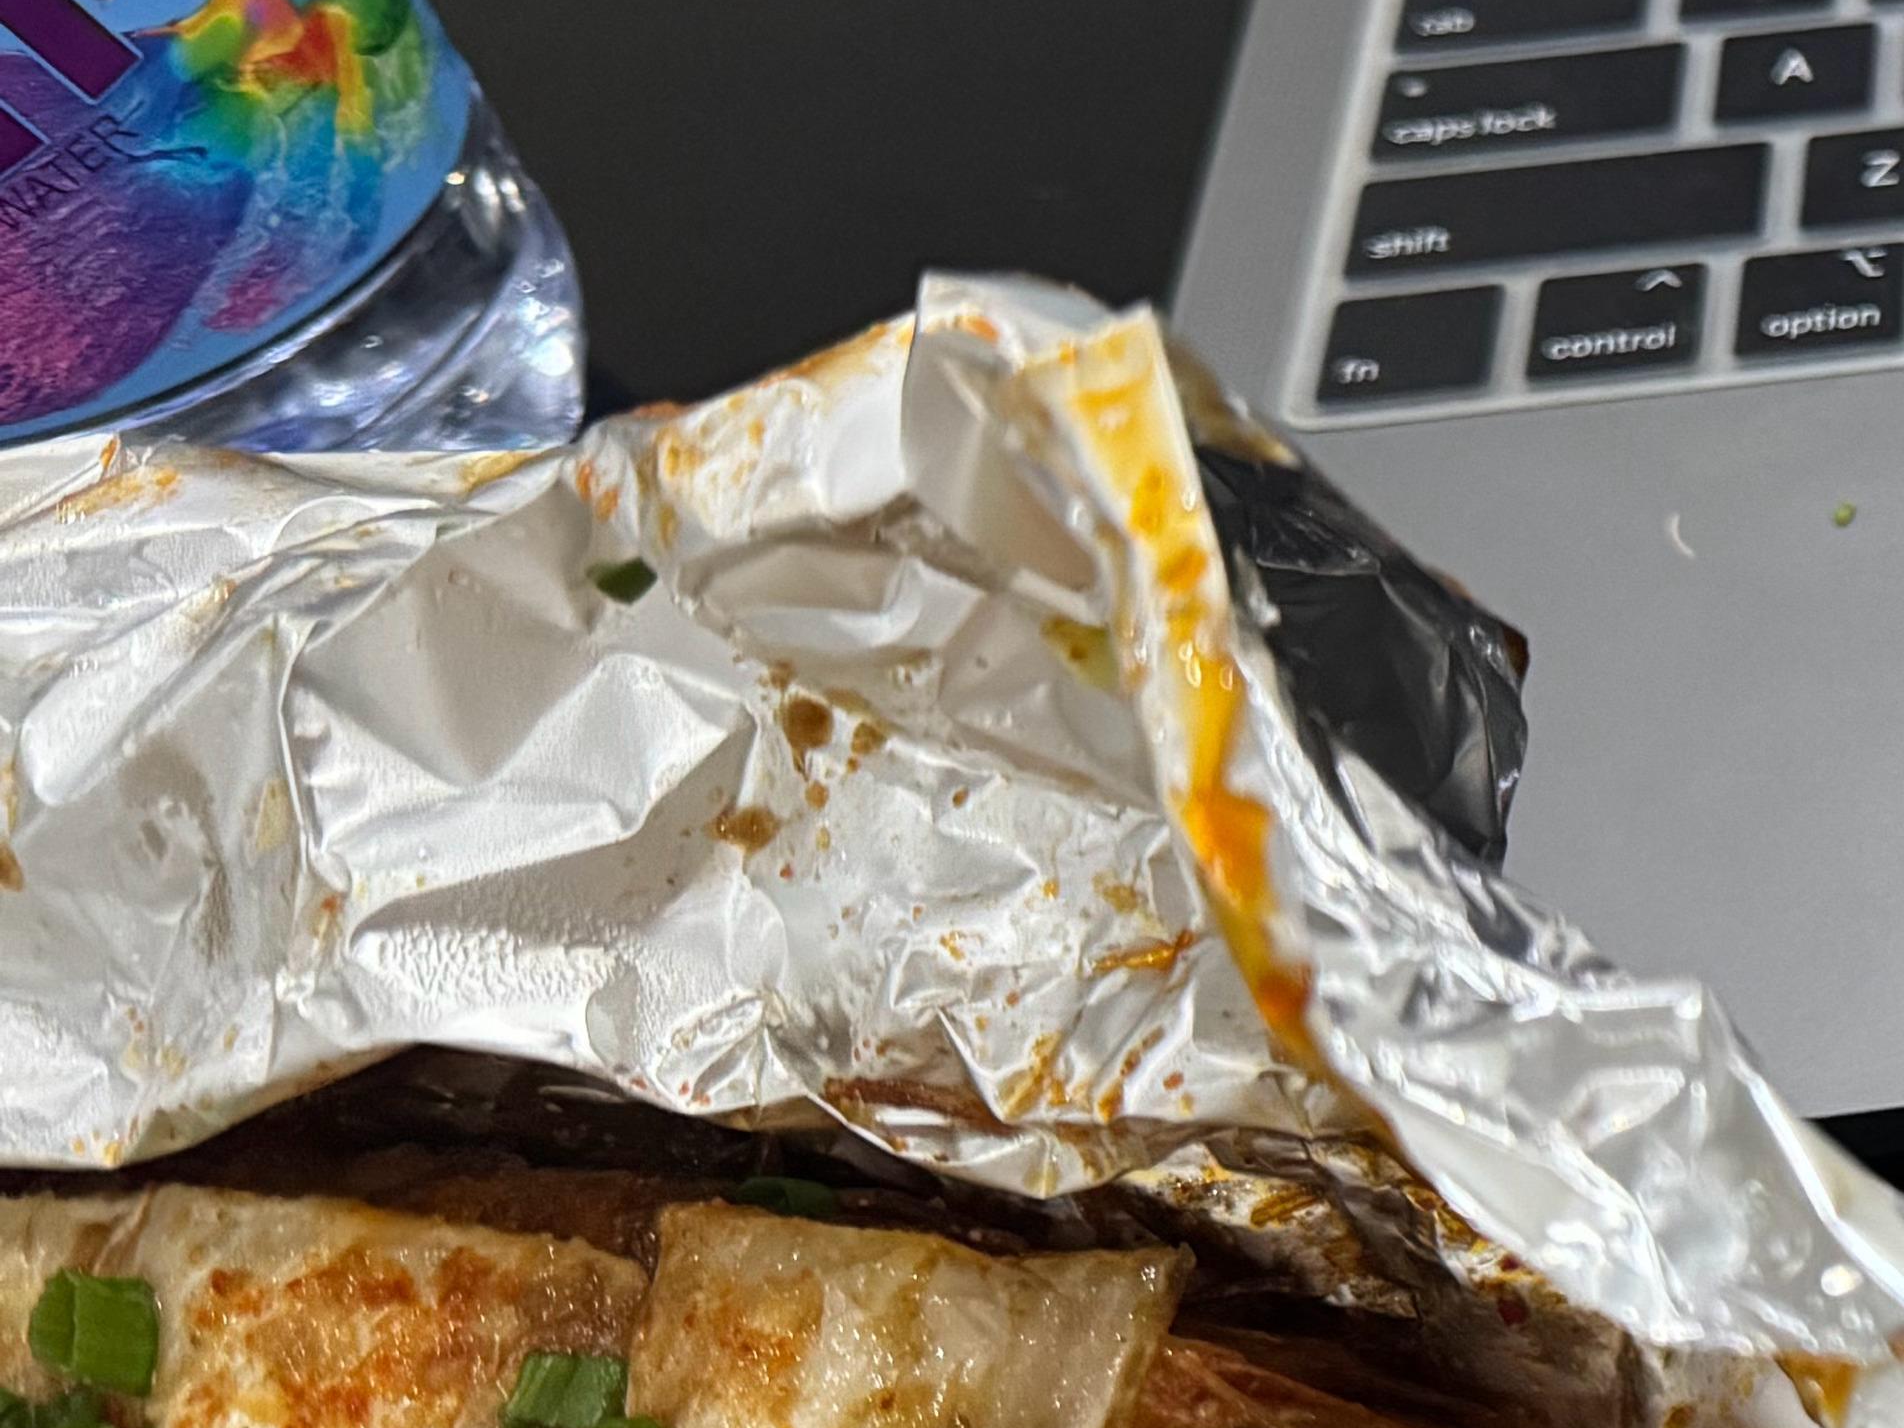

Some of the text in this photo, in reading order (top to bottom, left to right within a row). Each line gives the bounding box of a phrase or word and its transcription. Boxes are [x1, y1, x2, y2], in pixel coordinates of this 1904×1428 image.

[1776, 48, 1814, 86] A
[1367, 226, 1451, 260] shift
[1863, 148, 1901, 189] Z
[1546, 323, 1677, 361] control
[1764, 306, 1882, 340] option
